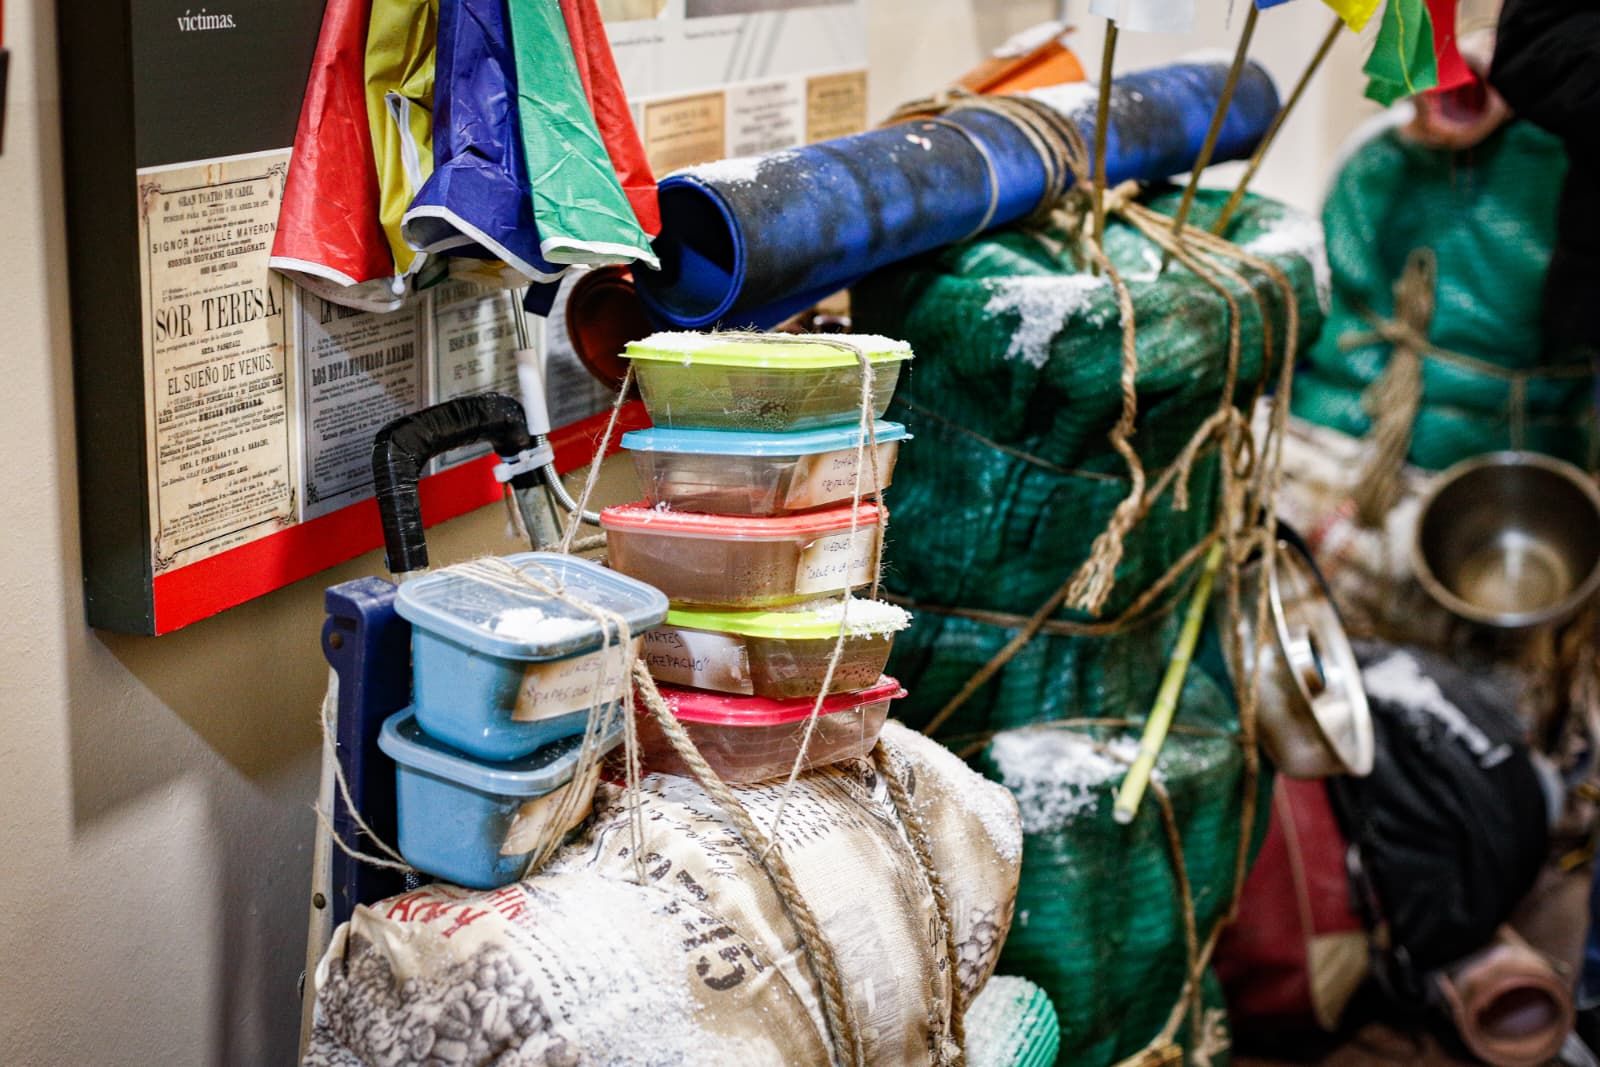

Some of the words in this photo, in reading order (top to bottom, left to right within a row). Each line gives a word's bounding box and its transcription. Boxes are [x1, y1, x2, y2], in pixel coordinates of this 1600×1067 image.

[177, 8, 236, 31] víctimas.
[152, 238, 188, 254] SIGNOR
[194, 230, 232, 246] ACHILLE
[155, 303, 193, 342] SOR
[202, 286, 281, 332] TERESA,
[168, 376, 181, 396] EL
[184, 366, 219, 391] SUEÑO
[222, 363, 236, 382] DE
[239, 353, 274, 376] VENUS.
